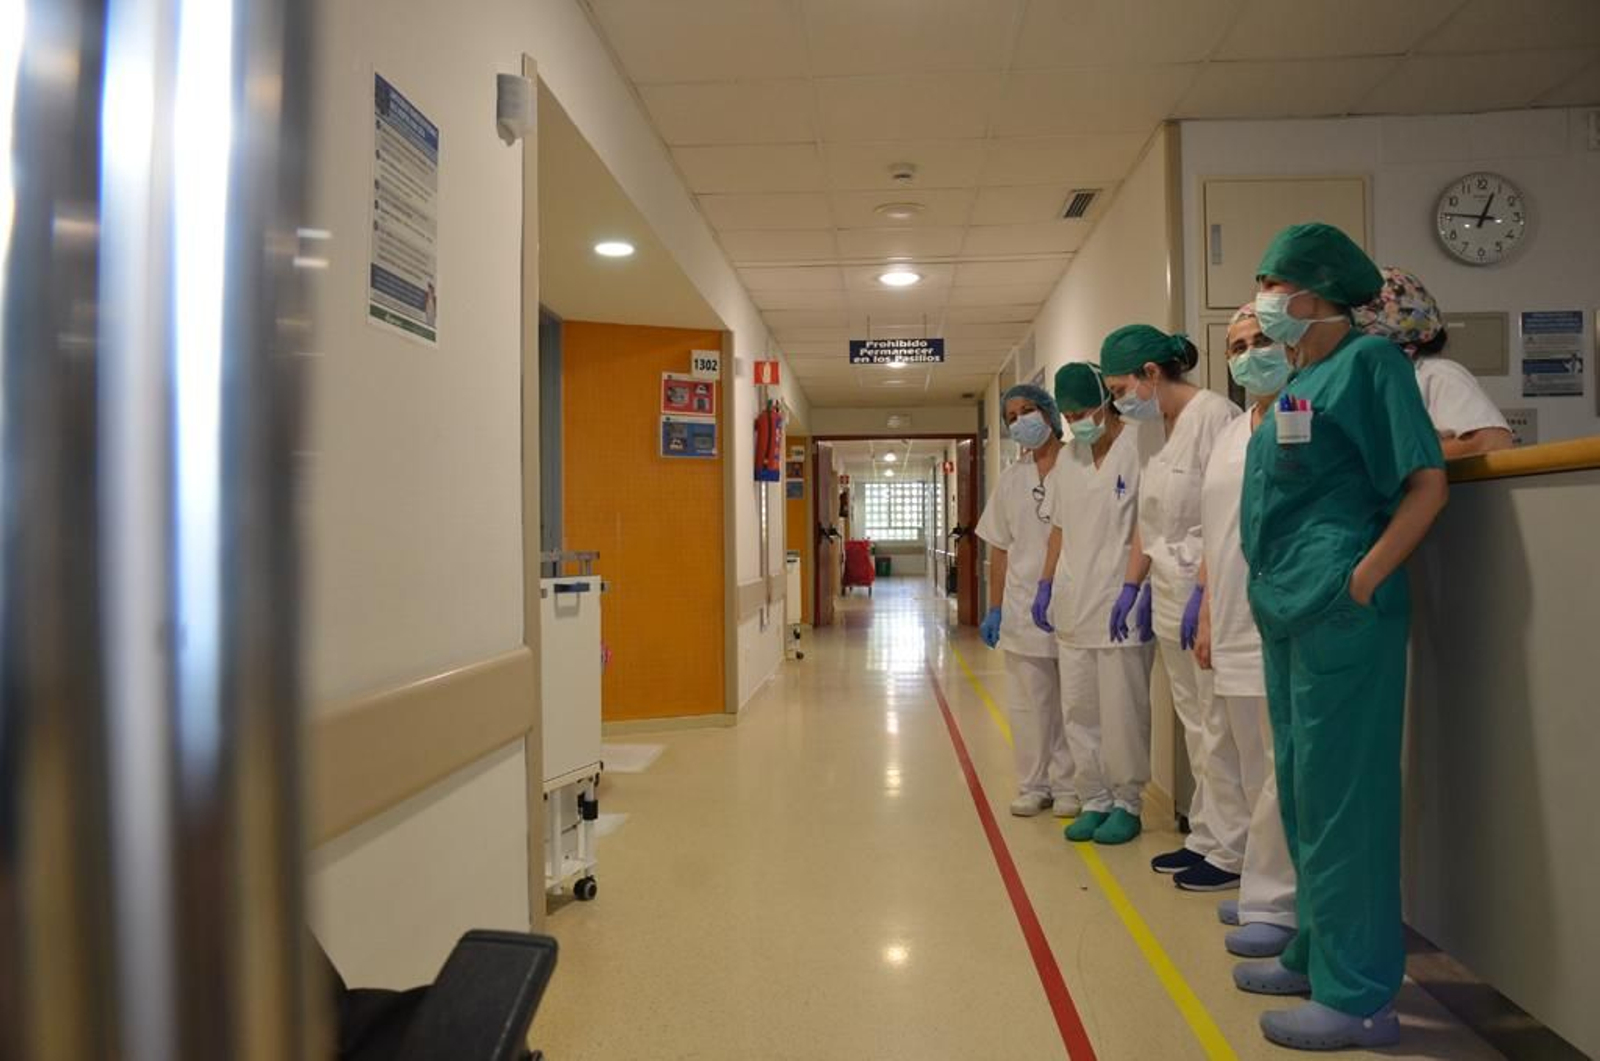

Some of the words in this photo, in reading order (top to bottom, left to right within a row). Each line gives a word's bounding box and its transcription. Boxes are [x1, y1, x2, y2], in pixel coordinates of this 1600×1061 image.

[1462, 183, 1471, 194] 11
[1475, 179, 1488, 190] 12
[1449, 195, 1459, 207] 10
[1507, 195, 1516, 207] 2
[1512, 212, 1521, 222] 3
[1449, 230, 1457, 240] 8
[1505, 229, 1514, 239] 4
[1460, 241, 1469, 255] 7
[1495, 241, 1503, 252] 5
[1477, 247, 1486, 257] 6
[865, 340, 928, 348] Prohibido
[859, 347, 934, 356] Permanecer
[873, 355, 891, 363] los
[894, 355, 940, 363] Pasillos
[693, 358, 718, 371] 1302
